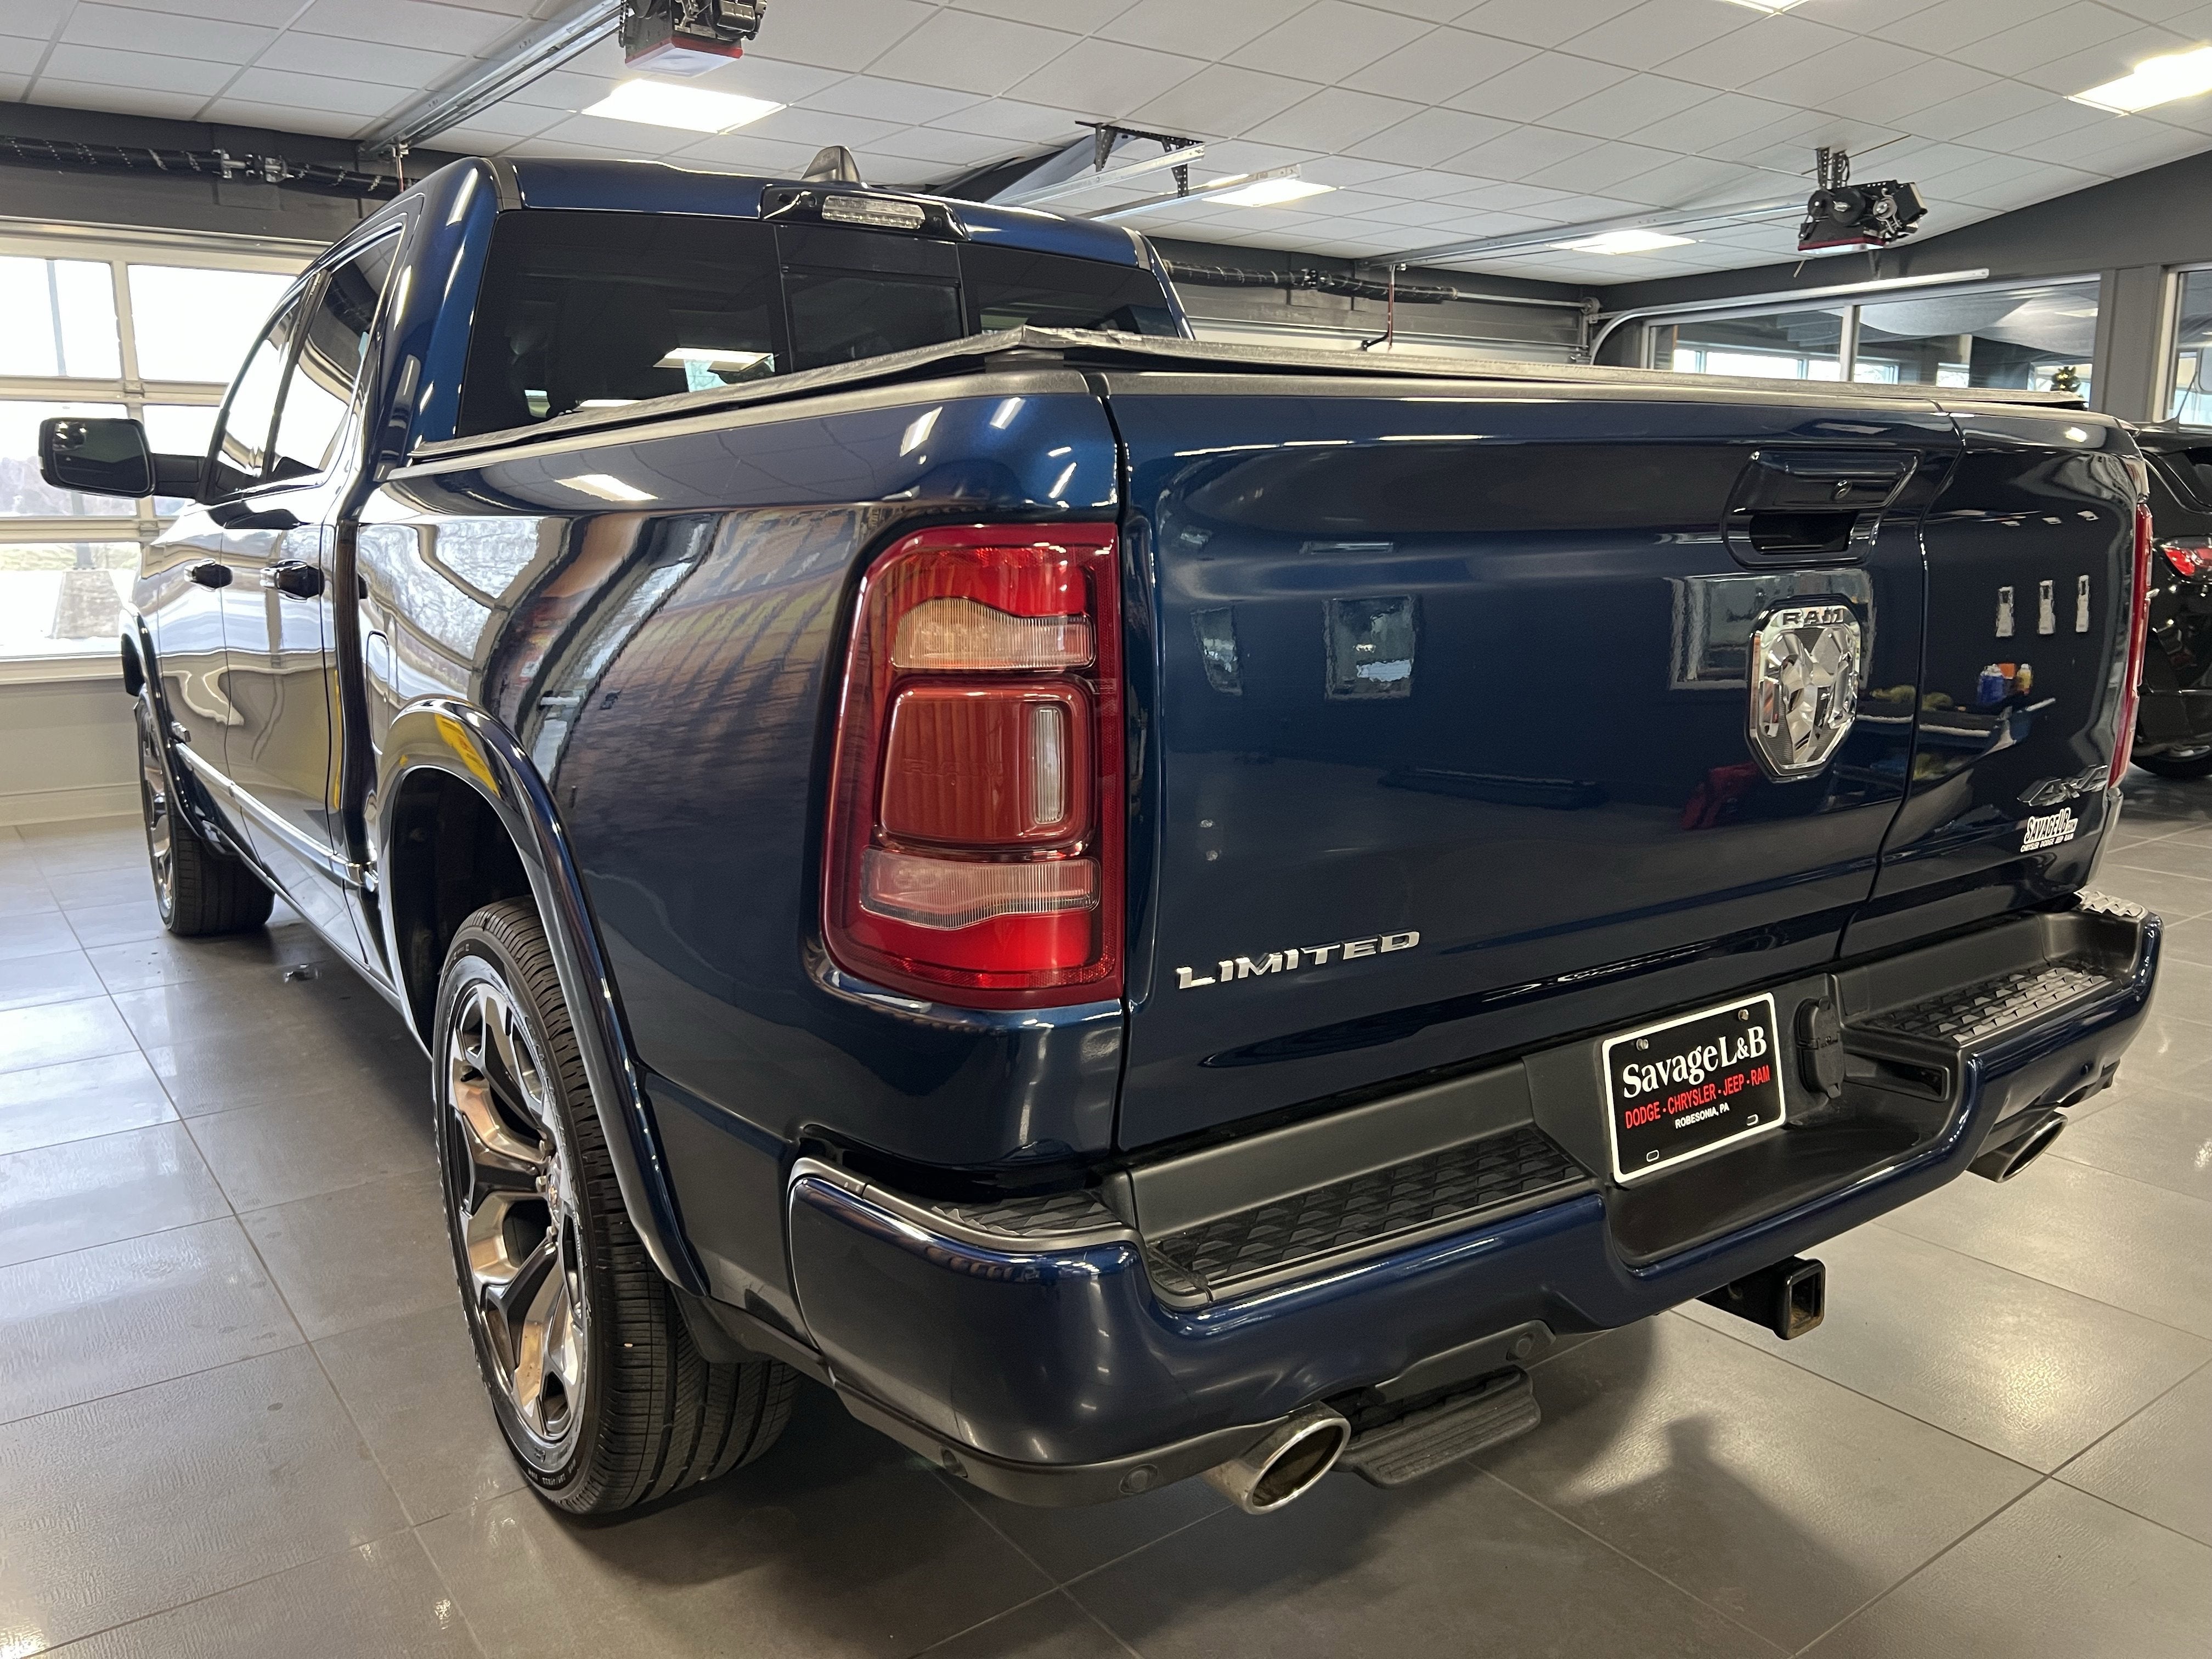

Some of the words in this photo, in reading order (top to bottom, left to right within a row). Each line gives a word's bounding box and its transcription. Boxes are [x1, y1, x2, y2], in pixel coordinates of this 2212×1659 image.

[1783, 607, 1844, 625] RAM
[1176, 930, 1420, 990] LIMITED
[1625, 1101, 1661, 1129] DODGE
[1667, 1083, 1717, 1115] CHRYSLER
[1723, 1073, 1745, 1096] JEEP
[1751, 1064, 1771, 1087] RAM
[1674, 1107, 1719, 1129] ROBESONIA,
[1719, 1102, 1730, 1114] PA
